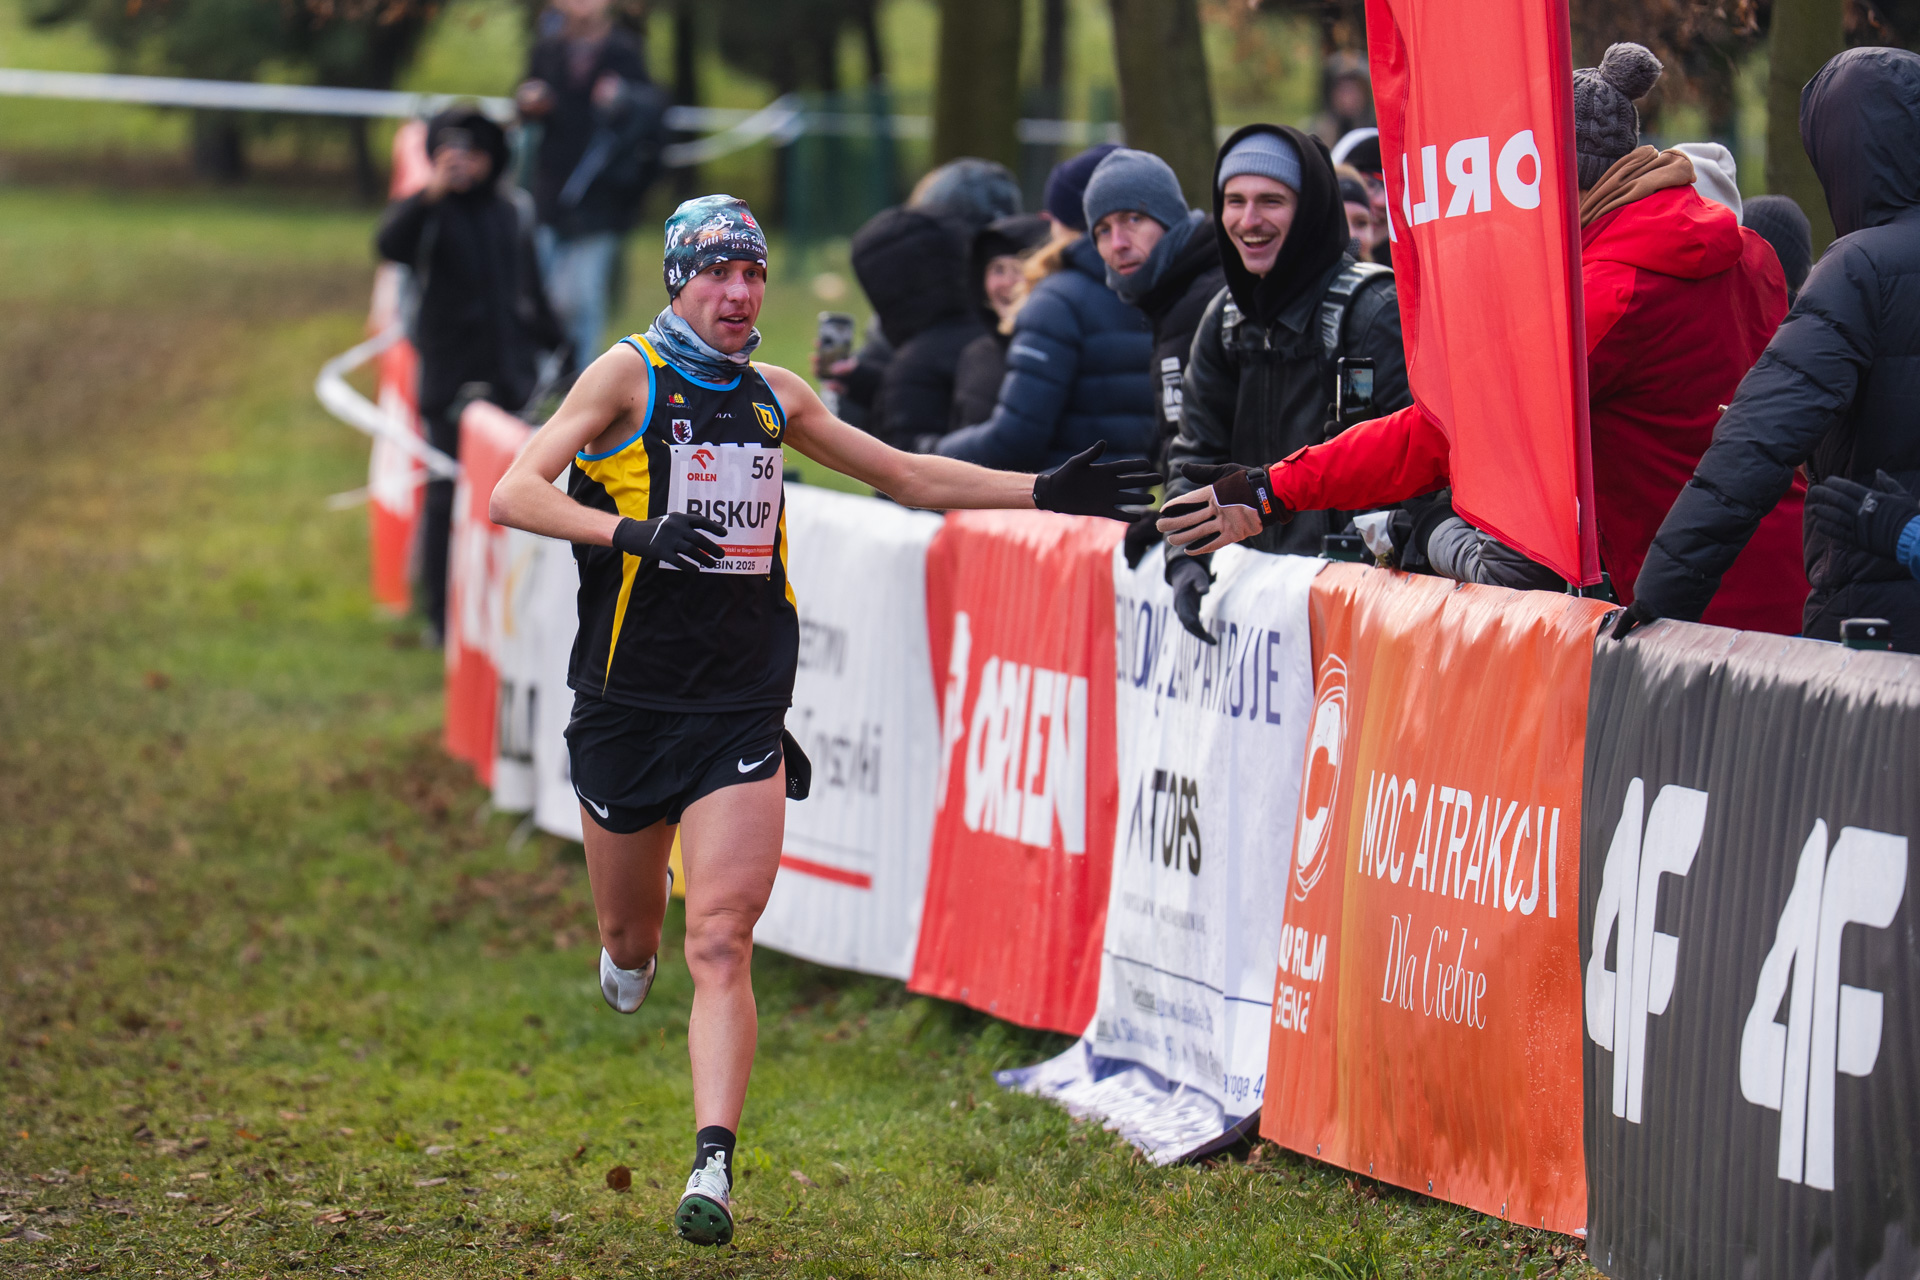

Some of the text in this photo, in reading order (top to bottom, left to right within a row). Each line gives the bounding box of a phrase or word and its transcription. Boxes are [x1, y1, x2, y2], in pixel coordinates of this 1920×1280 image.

[722, 232, 749, 241] BIEG
[687, 472, 717, 482] ORLEN
[751, 455, 774, 480] 56
[686, 498, 771, 529] BISKUP
[700, 560, 756, 571] BIN 2025
[964, 655, 1088, 855] ORLEN
[1358, 769, 1560, 918] MOC ATRAKCJI
[1381, 914, 1487, 1030] Dla Ciebie
[1585, 776, 1709, 1124] 4F
[1739, 817, 1908, 1191] 4F
